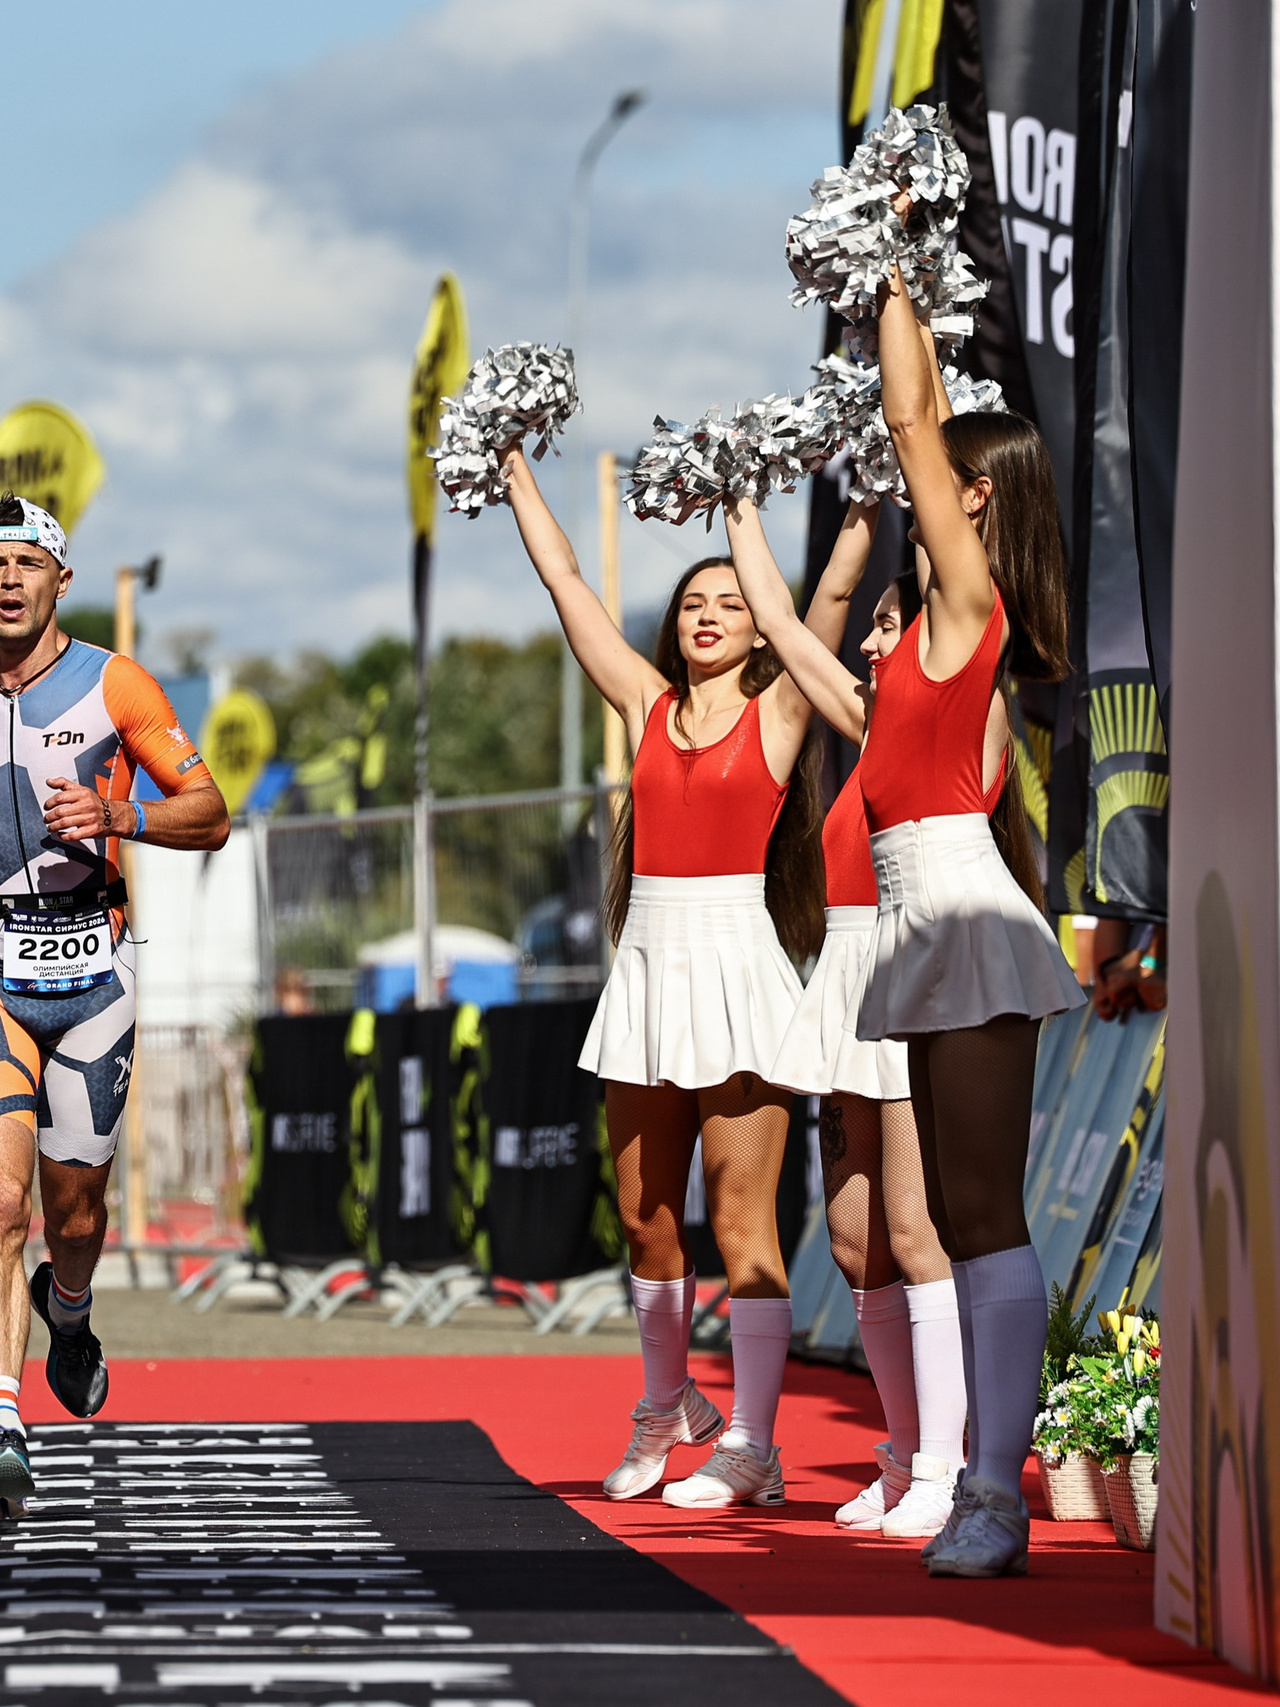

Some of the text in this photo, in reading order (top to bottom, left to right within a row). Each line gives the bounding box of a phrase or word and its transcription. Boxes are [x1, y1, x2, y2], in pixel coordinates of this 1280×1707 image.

[9, 923, 52, 933] IRONSTAR
[55, 922, 87, 932] СИРИУС
[18, 933, 99, 961] 2200
[33, 962, 89, 972] ОЛИМПИЙСКАЯ
[39, 969, 84, 978] ДИСТАНЦИЯ
[46, 980, 72, 989] GRAND
[73, 979, 94, 987] FINAL
